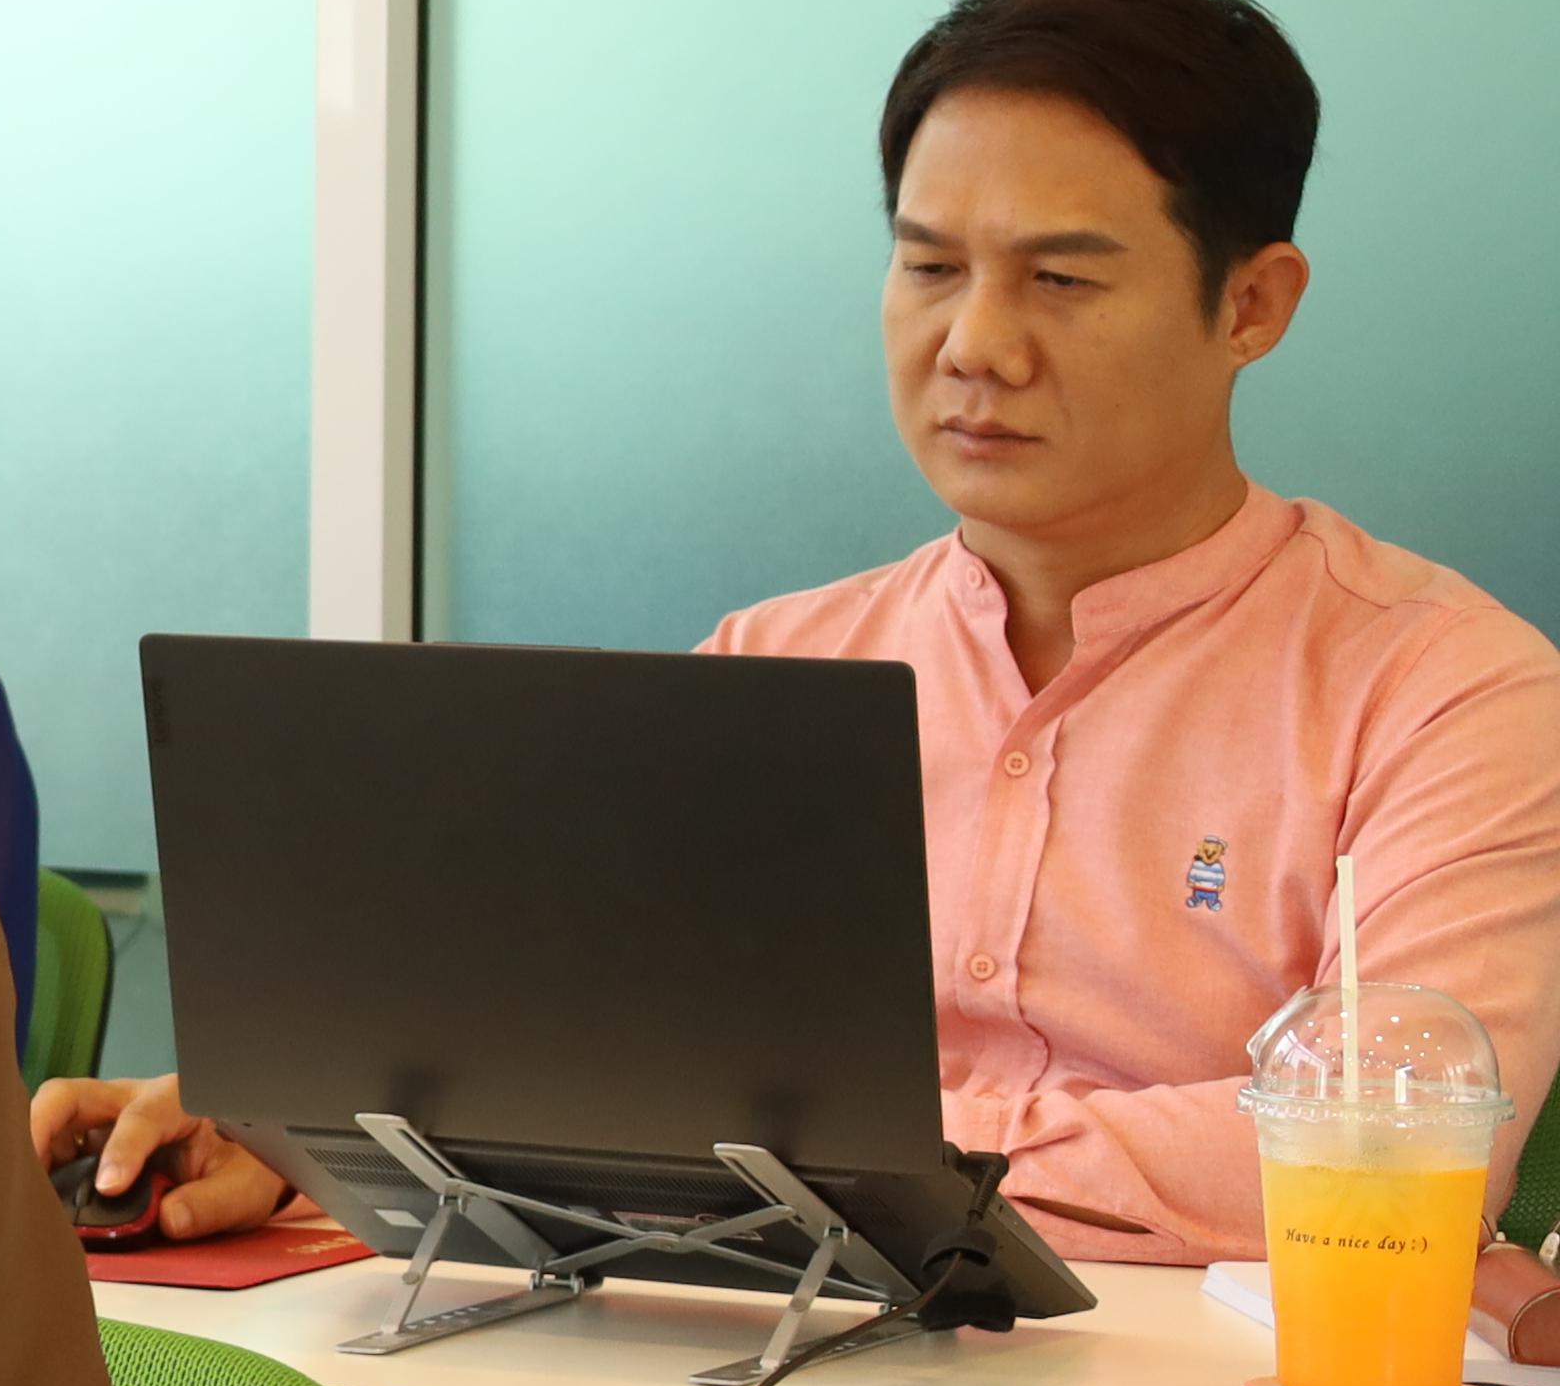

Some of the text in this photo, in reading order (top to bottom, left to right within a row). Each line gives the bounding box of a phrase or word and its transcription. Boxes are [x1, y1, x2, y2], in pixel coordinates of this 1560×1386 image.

[1286, 1227, 1316, 1245] Have
[1322, 1236, 1330, 1246] a
[1338, 1233, 1370, 1249] nice
